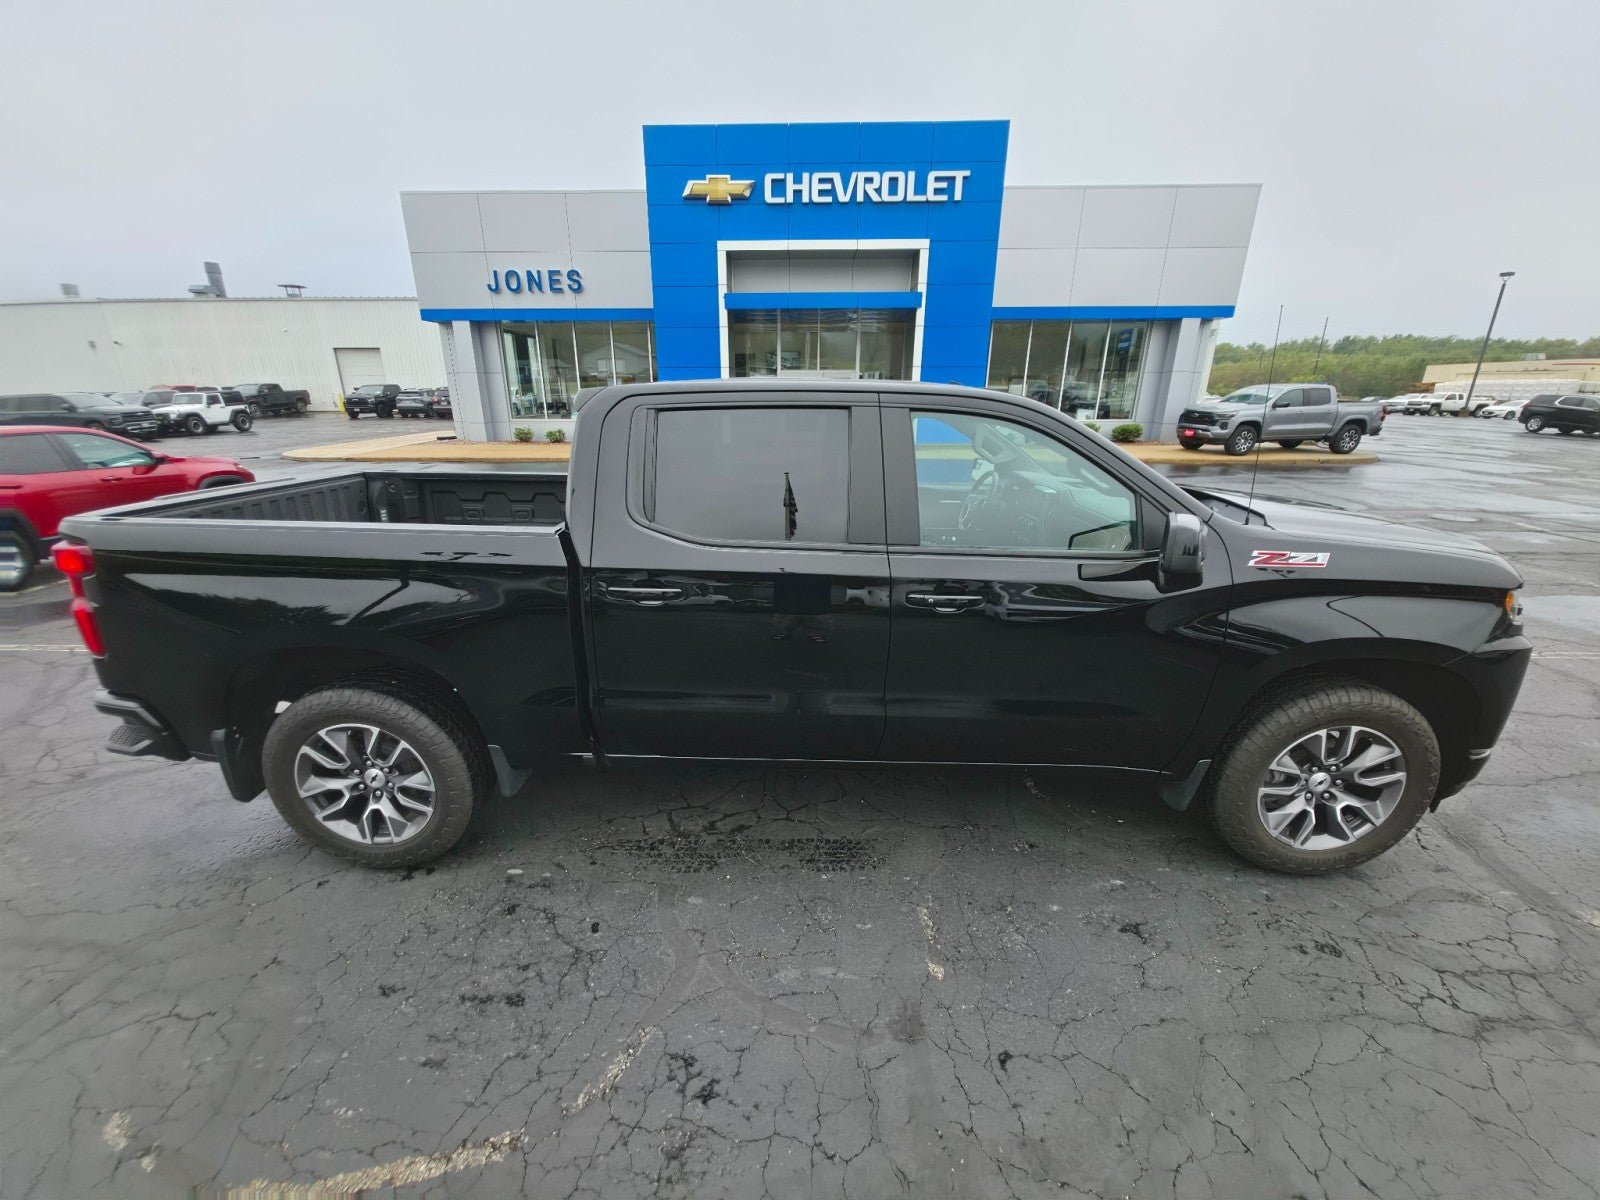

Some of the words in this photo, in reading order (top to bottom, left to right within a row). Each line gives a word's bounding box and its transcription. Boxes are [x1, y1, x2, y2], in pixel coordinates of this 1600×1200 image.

[764, 170, 971, 204] CHEVROLET
[487, 269, 583, 294] JONES
[1248, 550, 1331, 568] Z71
